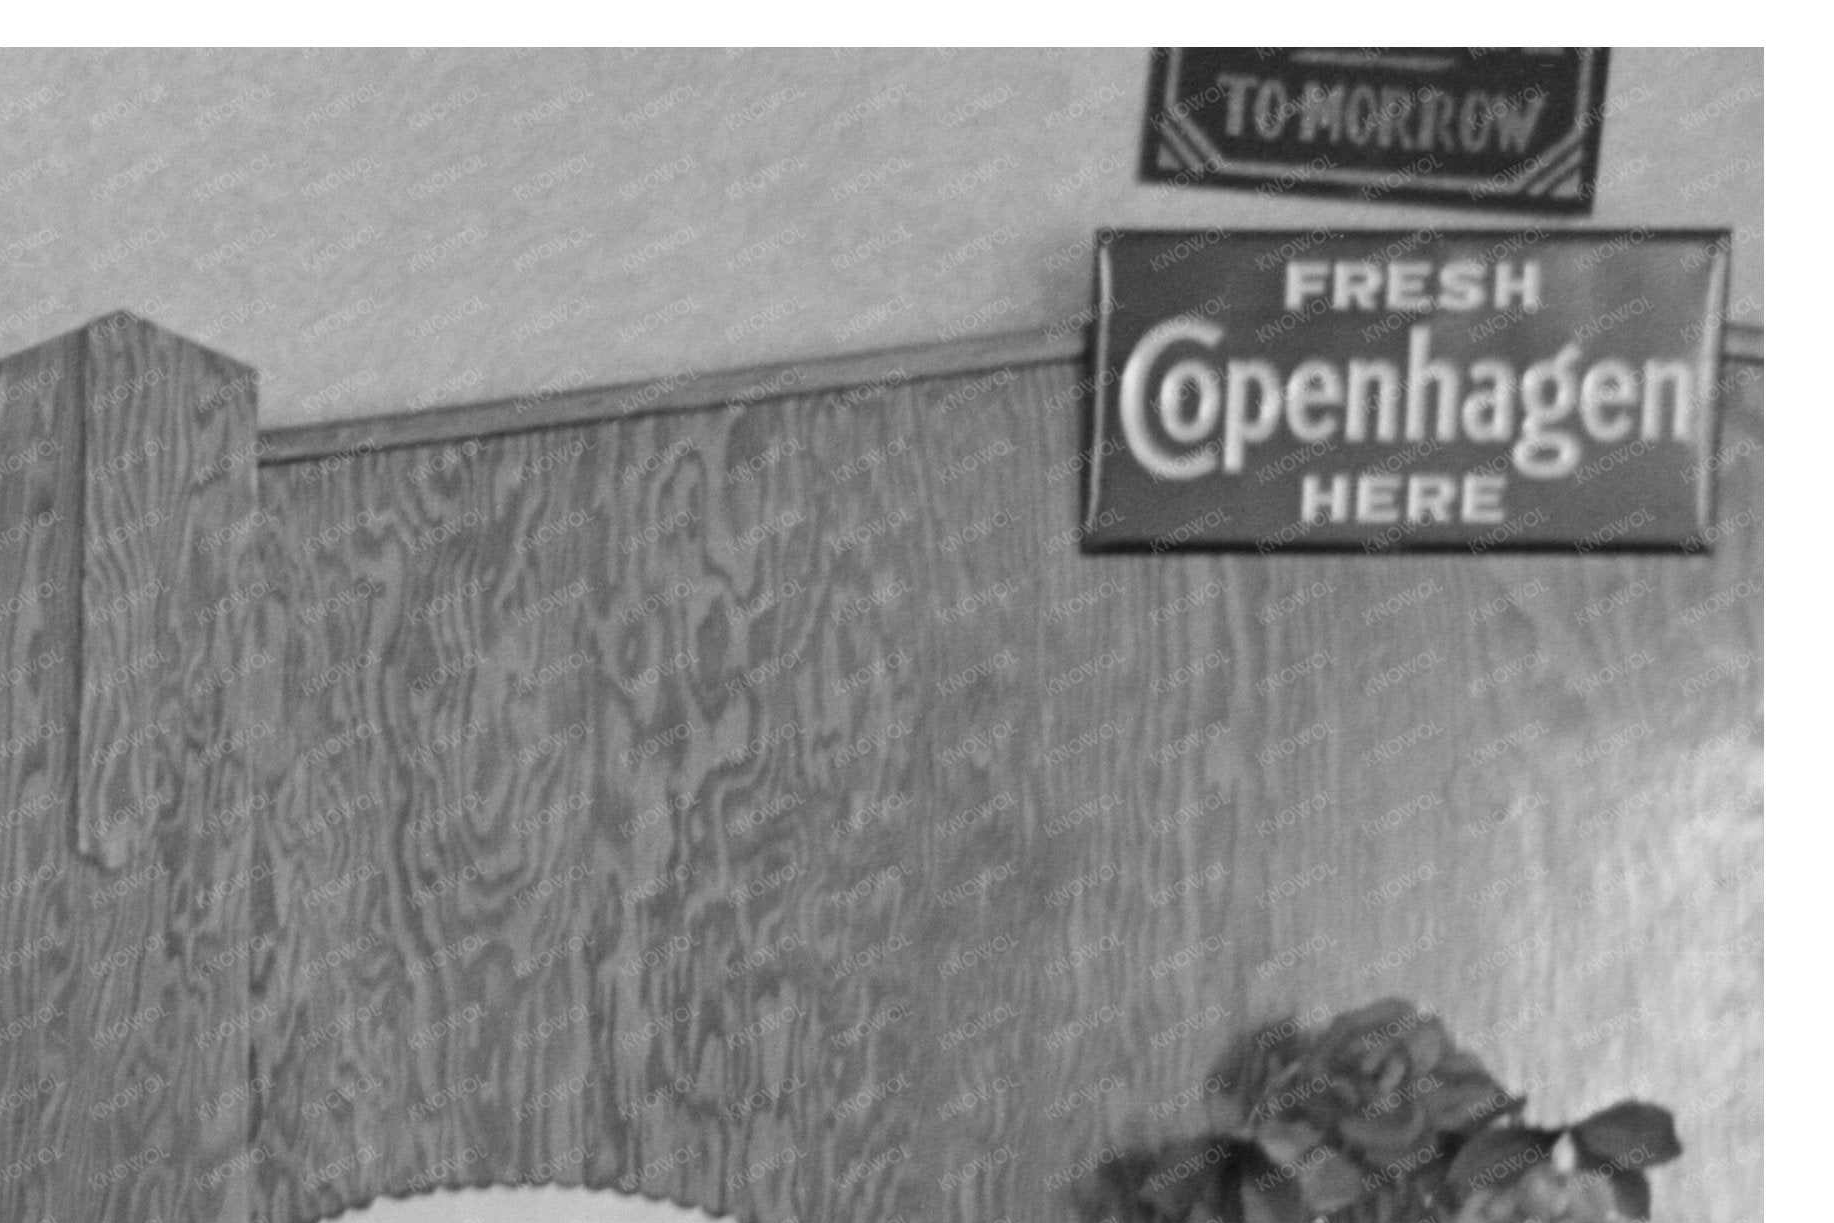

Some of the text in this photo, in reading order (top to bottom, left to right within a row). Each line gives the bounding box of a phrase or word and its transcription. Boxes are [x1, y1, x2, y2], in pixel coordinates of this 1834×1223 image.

[1283, 258, 1543, 312] FRESH
[1118, 318, 1696, 482] Copenhagen
[1298, 473, 1508, 524] HERE
